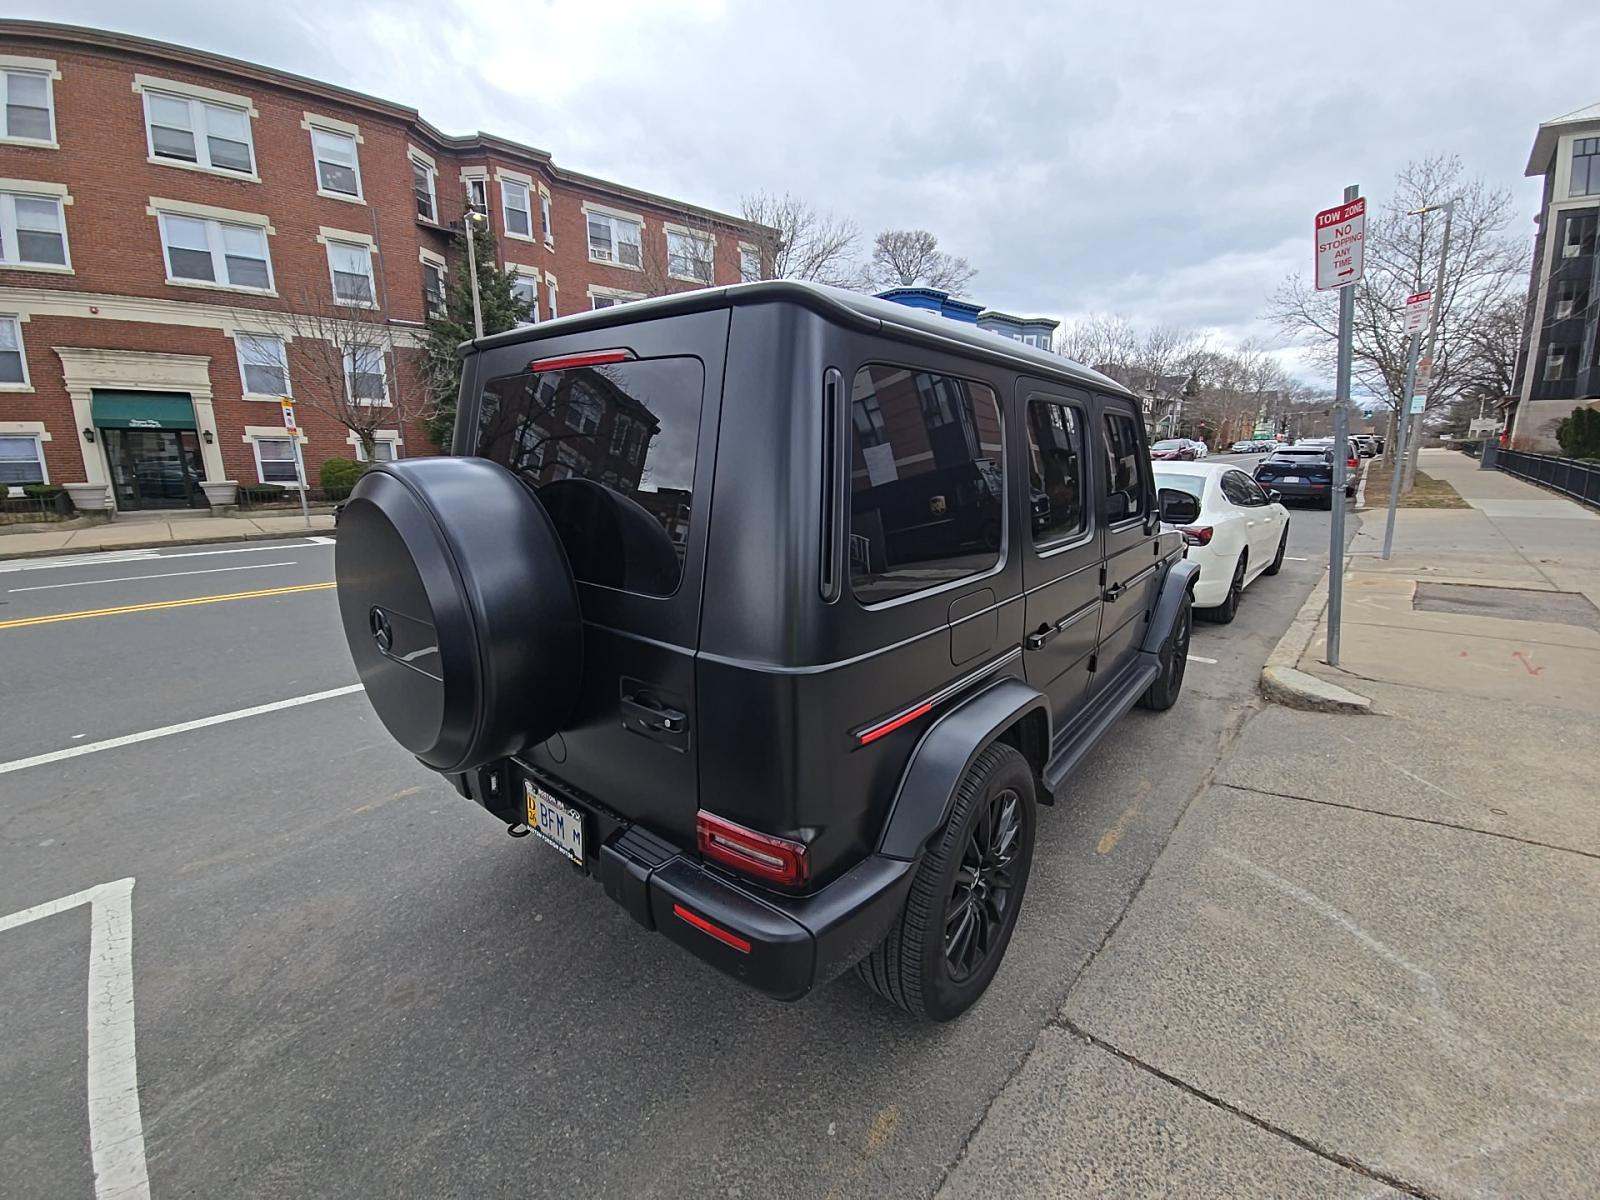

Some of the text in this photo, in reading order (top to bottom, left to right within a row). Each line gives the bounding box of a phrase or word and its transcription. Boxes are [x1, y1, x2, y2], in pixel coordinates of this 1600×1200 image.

[1319, 201, 1364, 226] TOW ZONE
[1335, 224, 1352, 239] NO
[1320, 232, 1363, 253] STOPPING
[1334, 246, 1351, 259] ANY
[1333, 256, 1353, 269] TIME
[540, 803, 566, 840] BFM
